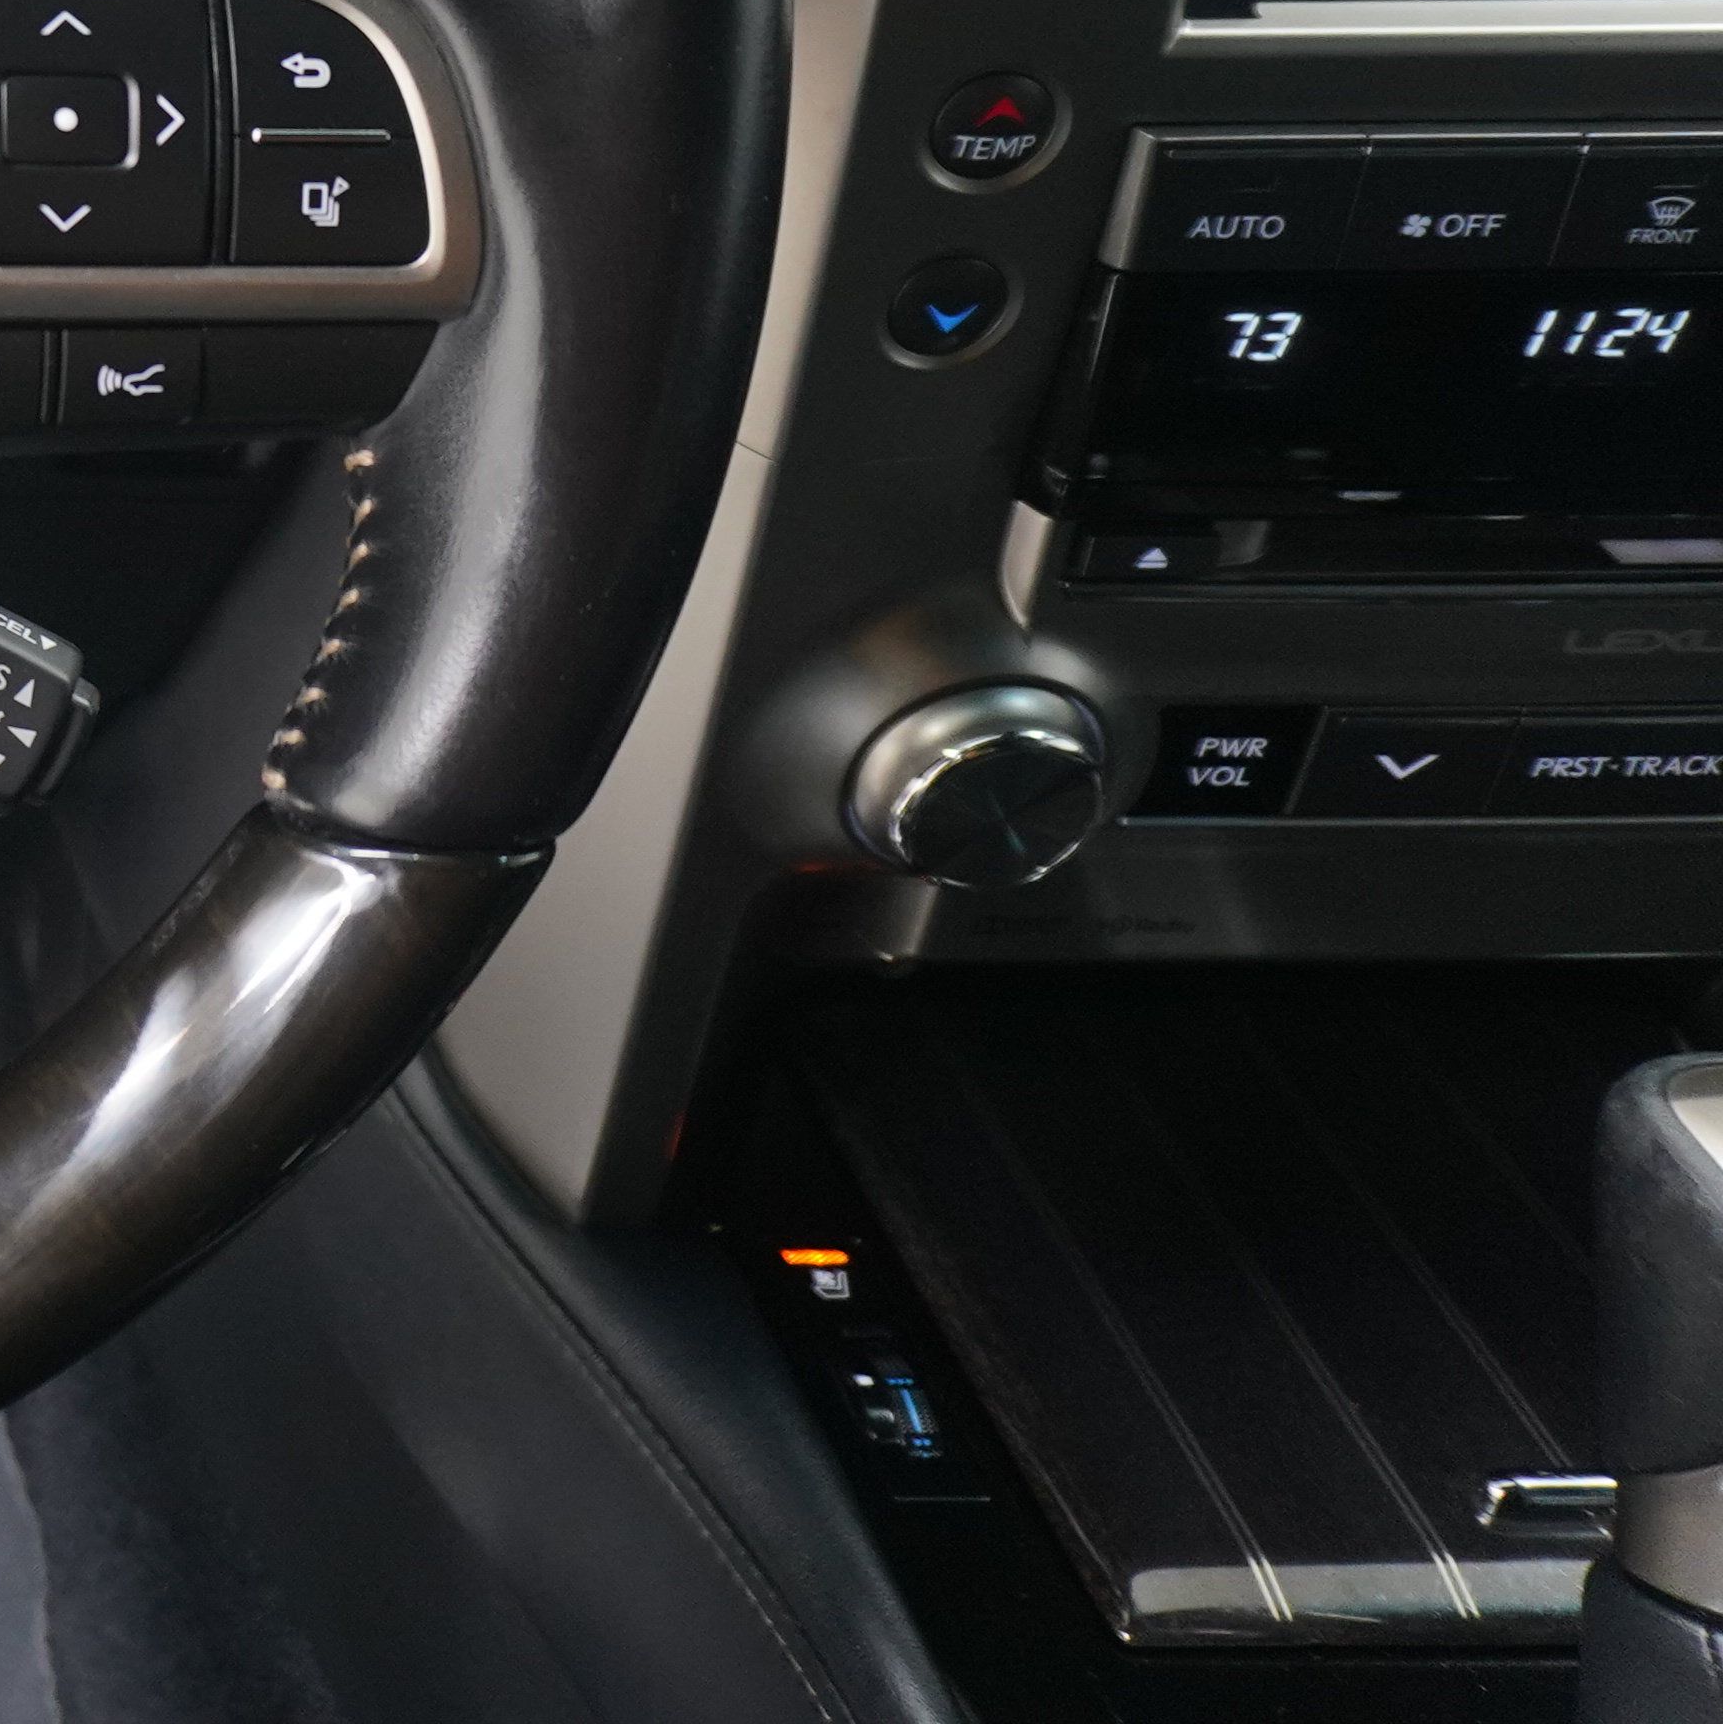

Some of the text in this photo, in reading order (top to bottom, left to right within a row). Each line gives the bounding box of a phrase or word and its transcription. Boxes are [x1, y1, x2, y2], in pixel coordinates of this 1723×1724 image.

[954, 131, 1037, 162] TEMP
[1187, 212, 1507, 240] AUTO OFF
[1625, 227, 1700, 245] FRONT
[1224, 311, 1304, 363] 73
[1194, 736, 1269, 759] PWR
[1187, 765, 1253, 787] VOL
